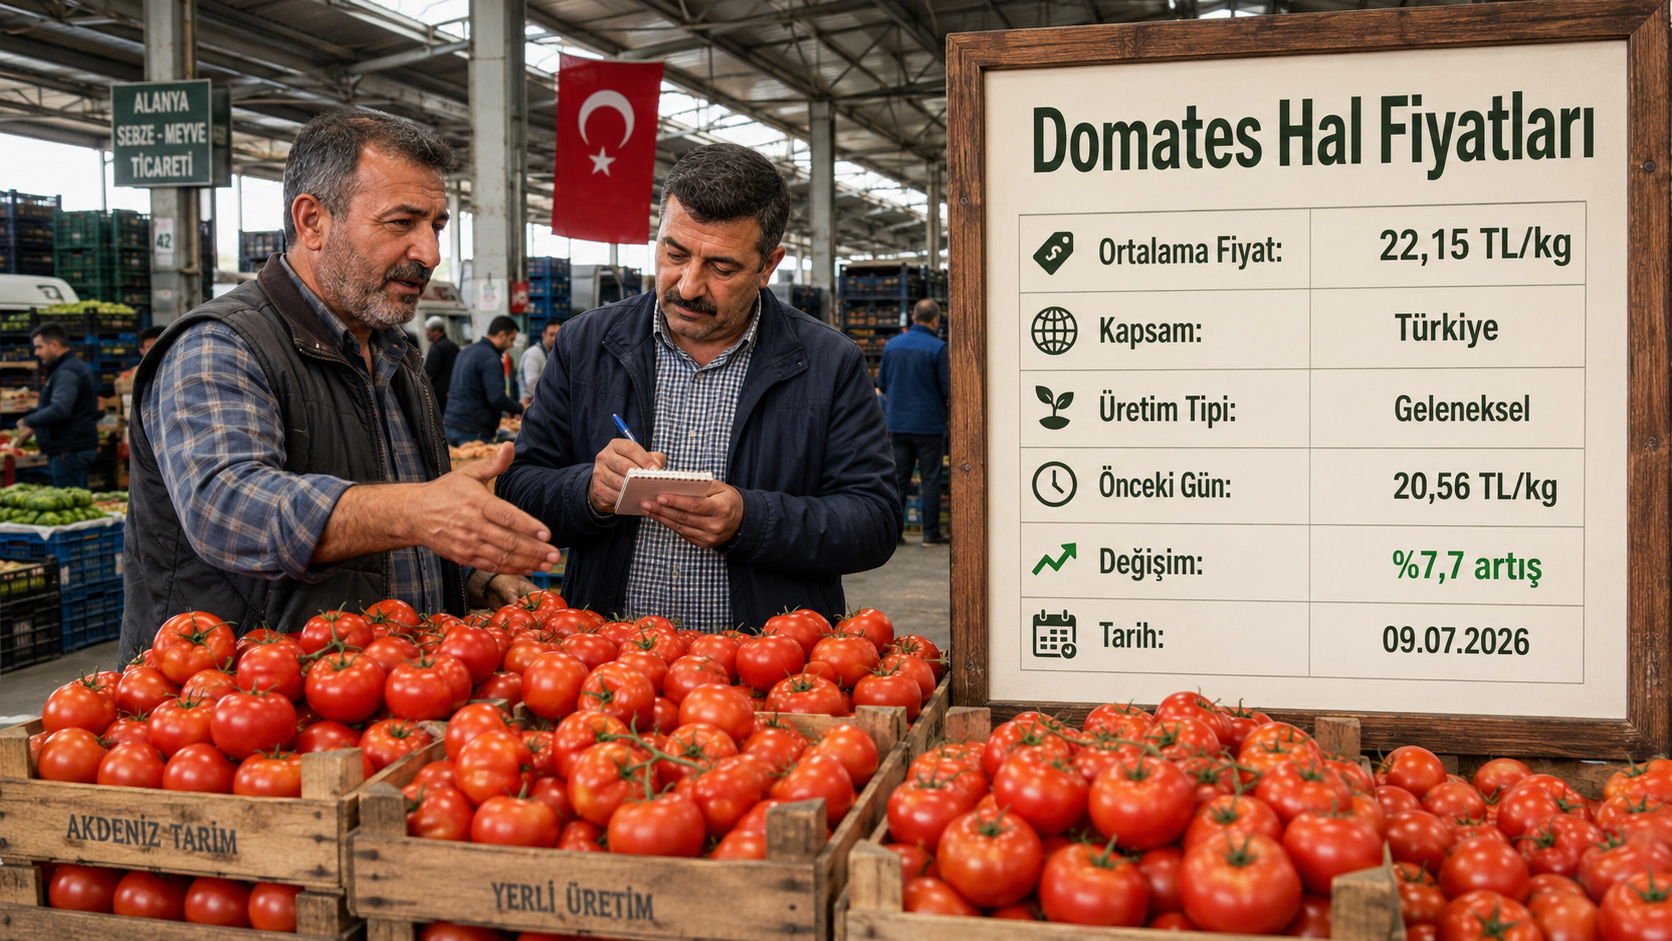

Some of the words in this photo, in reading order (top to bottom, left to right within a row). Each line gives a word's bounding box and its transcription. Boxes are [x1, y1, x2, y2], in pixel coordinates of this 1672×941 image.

[133, 90, 190, 114] ALANYA
[116, 124, 155, 147] SEBZE
[165, 122, 206, 145] MEYVE
[1032, 105, 1263, 174] Domates
[1278, 96, 1363, 167] Hal
[1380, 90, 1595, 181] Fiyatları
[130, 151, 193, 178] TİCARETİ
[156, 232, 171, 249] 42
[1099, 236, 1209, 266] Ortalama
[1217, 235, 1283, 271] Fiyat:
[1379, 227, 1471, 267] 22,15
[1480, 226, 1572, 267] TL/kg
[1099, 317, 1203, 351] Kapsam:
[1394, 312, 1499, 349] Türkiye
[1099, 389, 1178, 423] Üretim
[1185, 394, 1237, 429] Tipi:
[1394, 394, 1530, 423] Geleneksel
[1099, 465, 1174, 499] Önceki
[1180, 465, 1232, 499] Gün:
[1393, 471, 1471, 505] 20,56
[1479, 471, 1558, 508] TL/kg
[1099, 547, 1203, 582] Değişim:
[1392, 549, 1464, 585] %7,7
[1474, 551, 1543, 589] artış
[1098, 621, 1165, 649] Tarih:
[1382, 625, 1530, 656] 09.07.2026
[67, 814, 161, 848] AKDENİZ
[170, 821, 238, 855] TARİM
[490, 879, 556, 914] YERLİ
[566, 881, 654, 921] ÜRETİM
